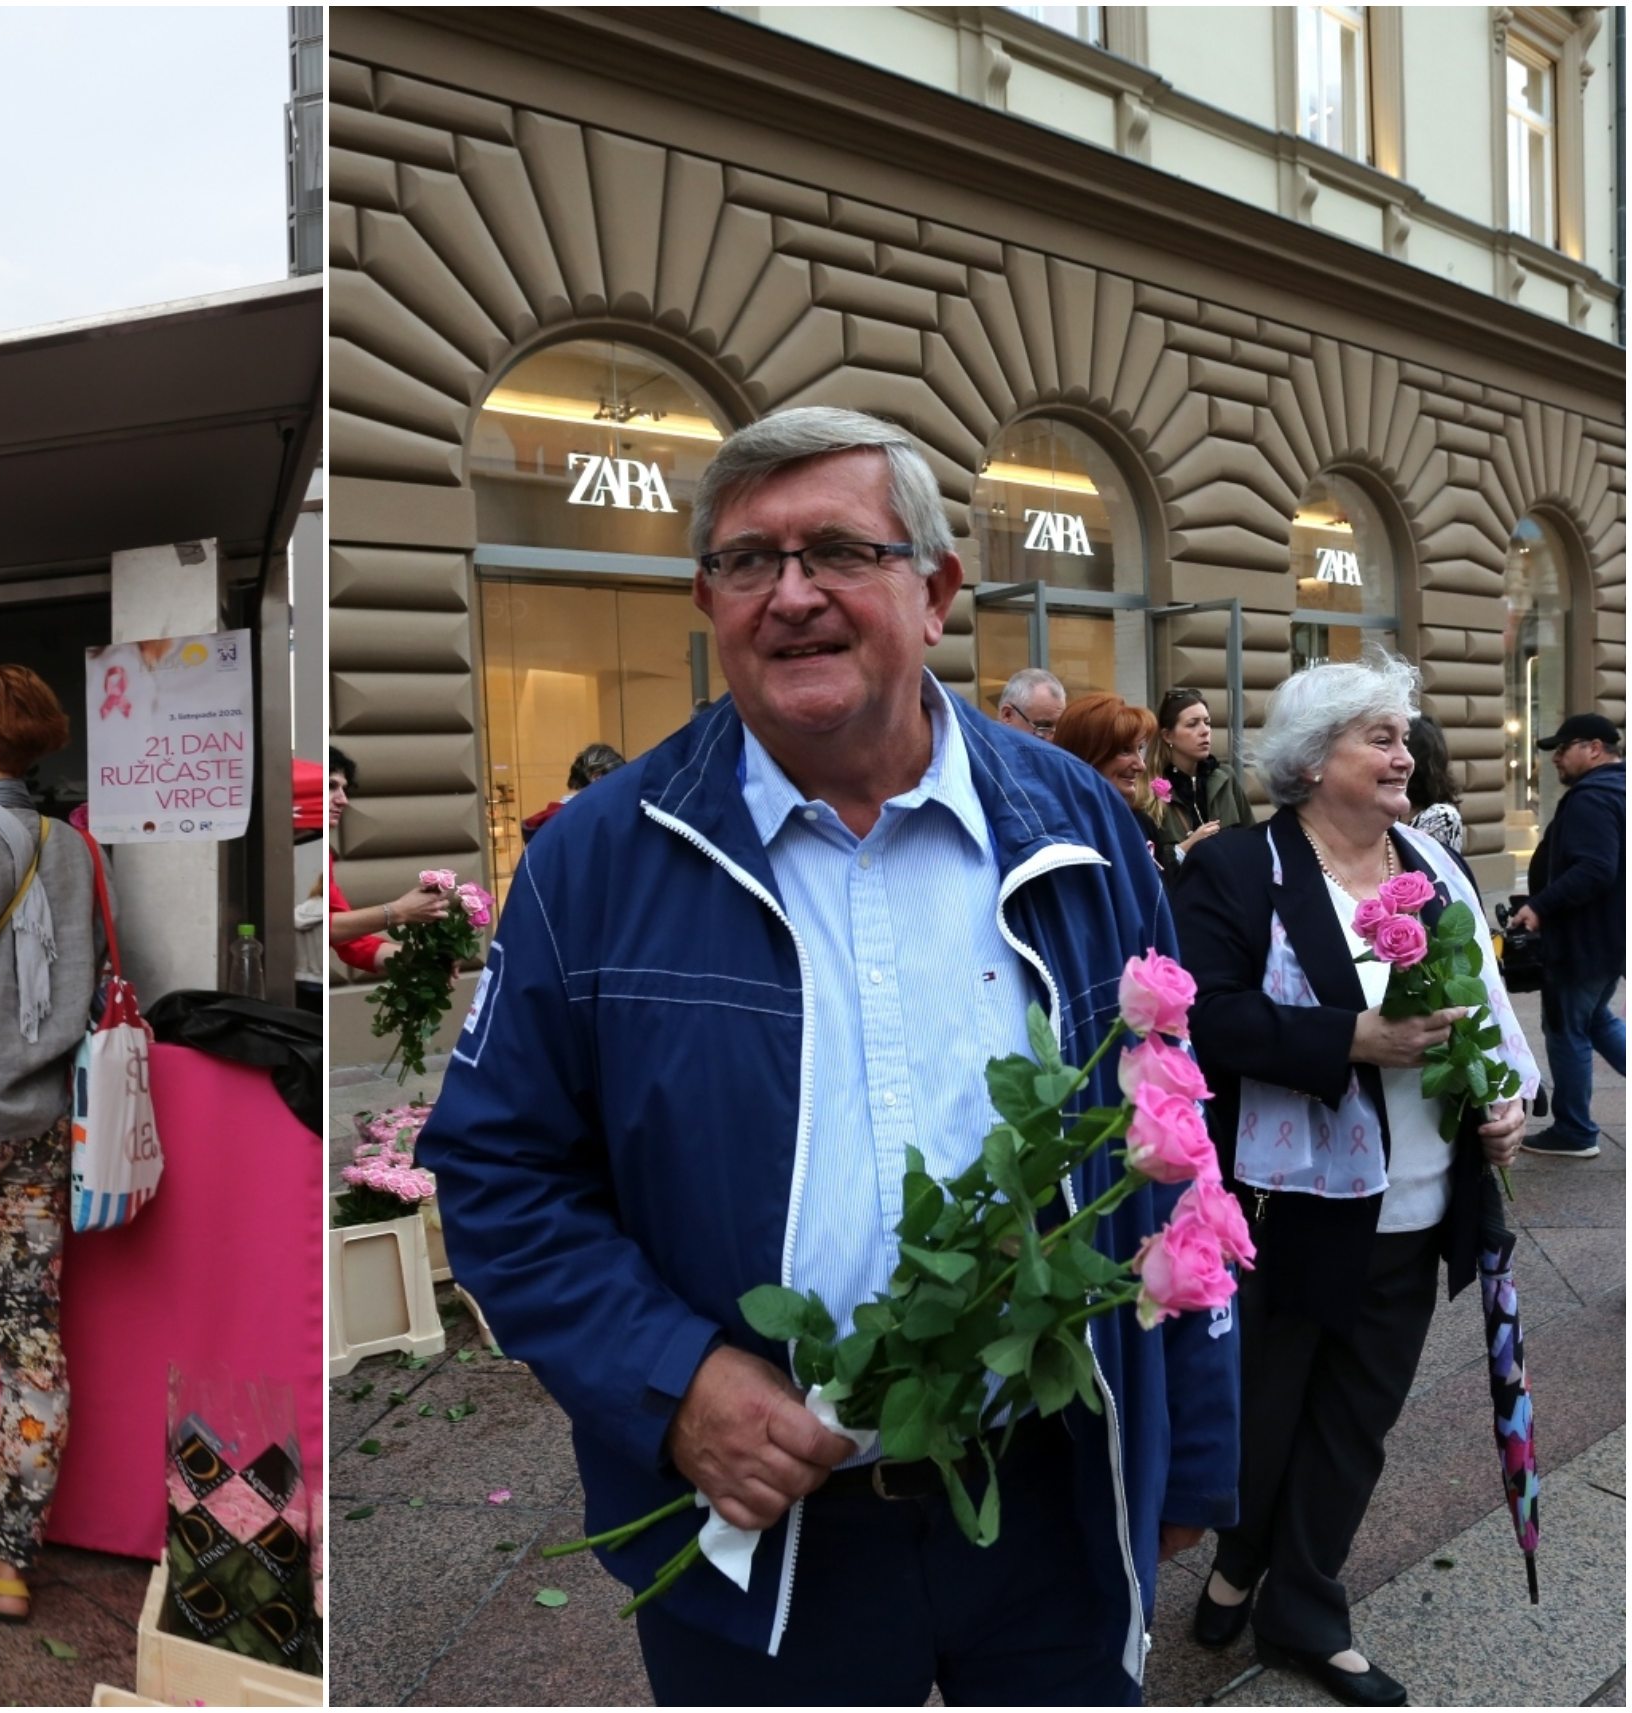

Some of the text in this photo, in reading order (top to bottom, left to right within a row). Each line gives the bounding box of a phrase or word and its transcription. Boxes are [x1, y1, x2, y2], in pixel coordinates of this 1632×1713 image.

[567, 453, 678, 514] ZARA
[1023, 508, 1095, 556] ZARA
[1315, 547, 1364, 587] ZARA
[145, 731, 244, 757] 21. DAN
[101, 757, 244, 787] RUŽIČASTE
[155, 785, 244, 809] VRPCE
